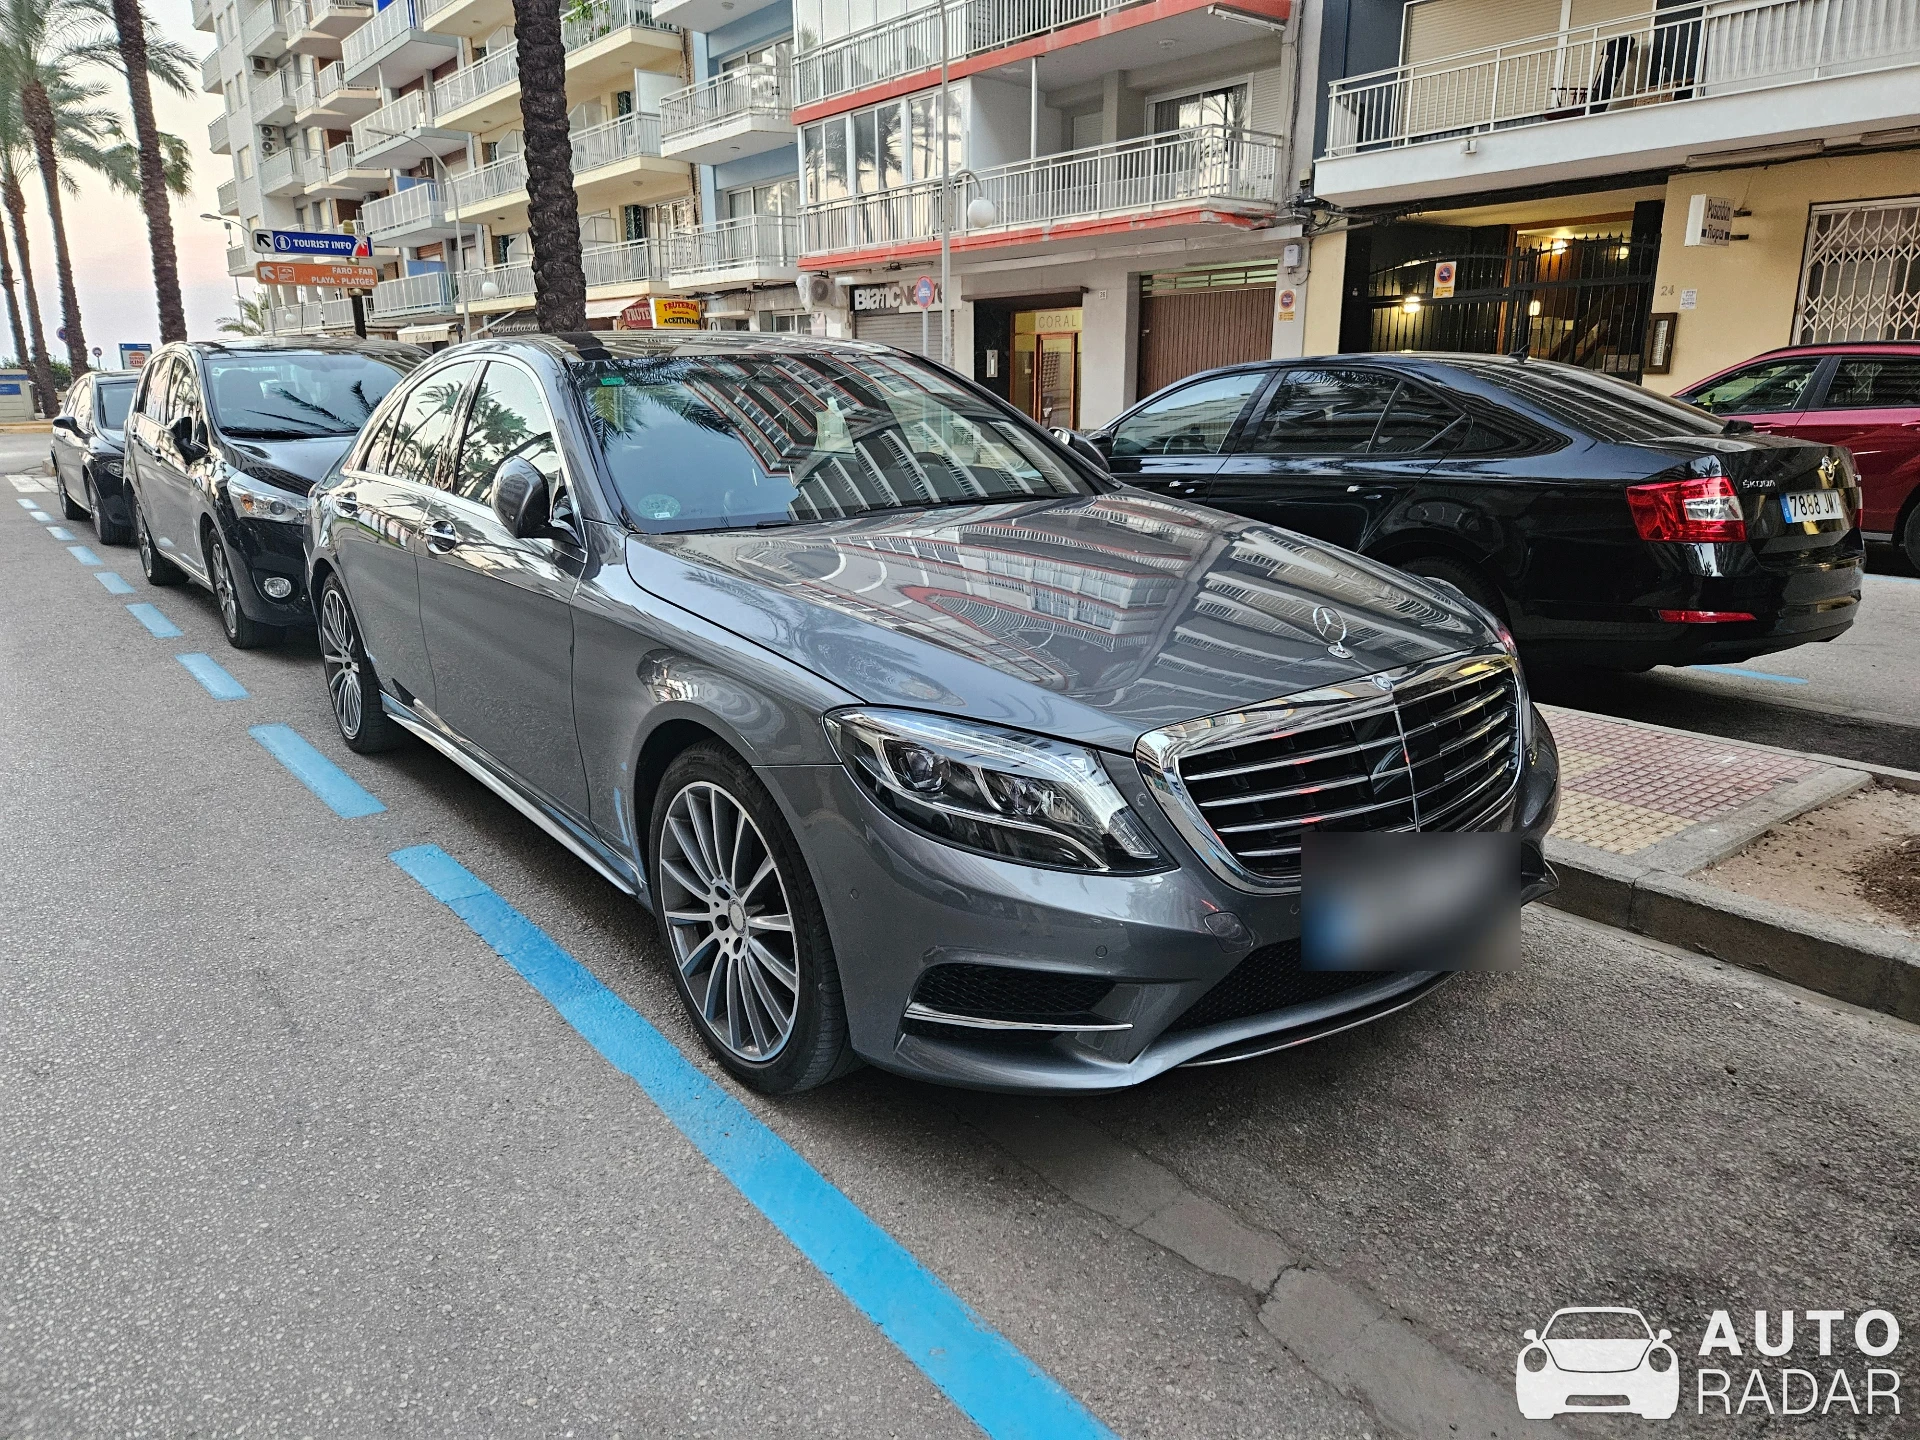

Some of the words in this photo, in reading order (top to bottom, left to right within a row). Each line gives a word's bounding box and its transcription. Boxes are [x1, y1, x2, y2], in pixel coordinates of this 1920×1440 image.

[293, 239, 329, 249] TOURIST
[332, 241, 352, 250] INFO
[332, 266, 352, 275] FARO
[358, 267, 373, 276] FAR
[311, 276, 335, 285] PLAYA
[341, 277, 375, 286] PLATGES
[1660, 284, 1675, 297] 24
[1038, 314, 1077, 329] CORAL
